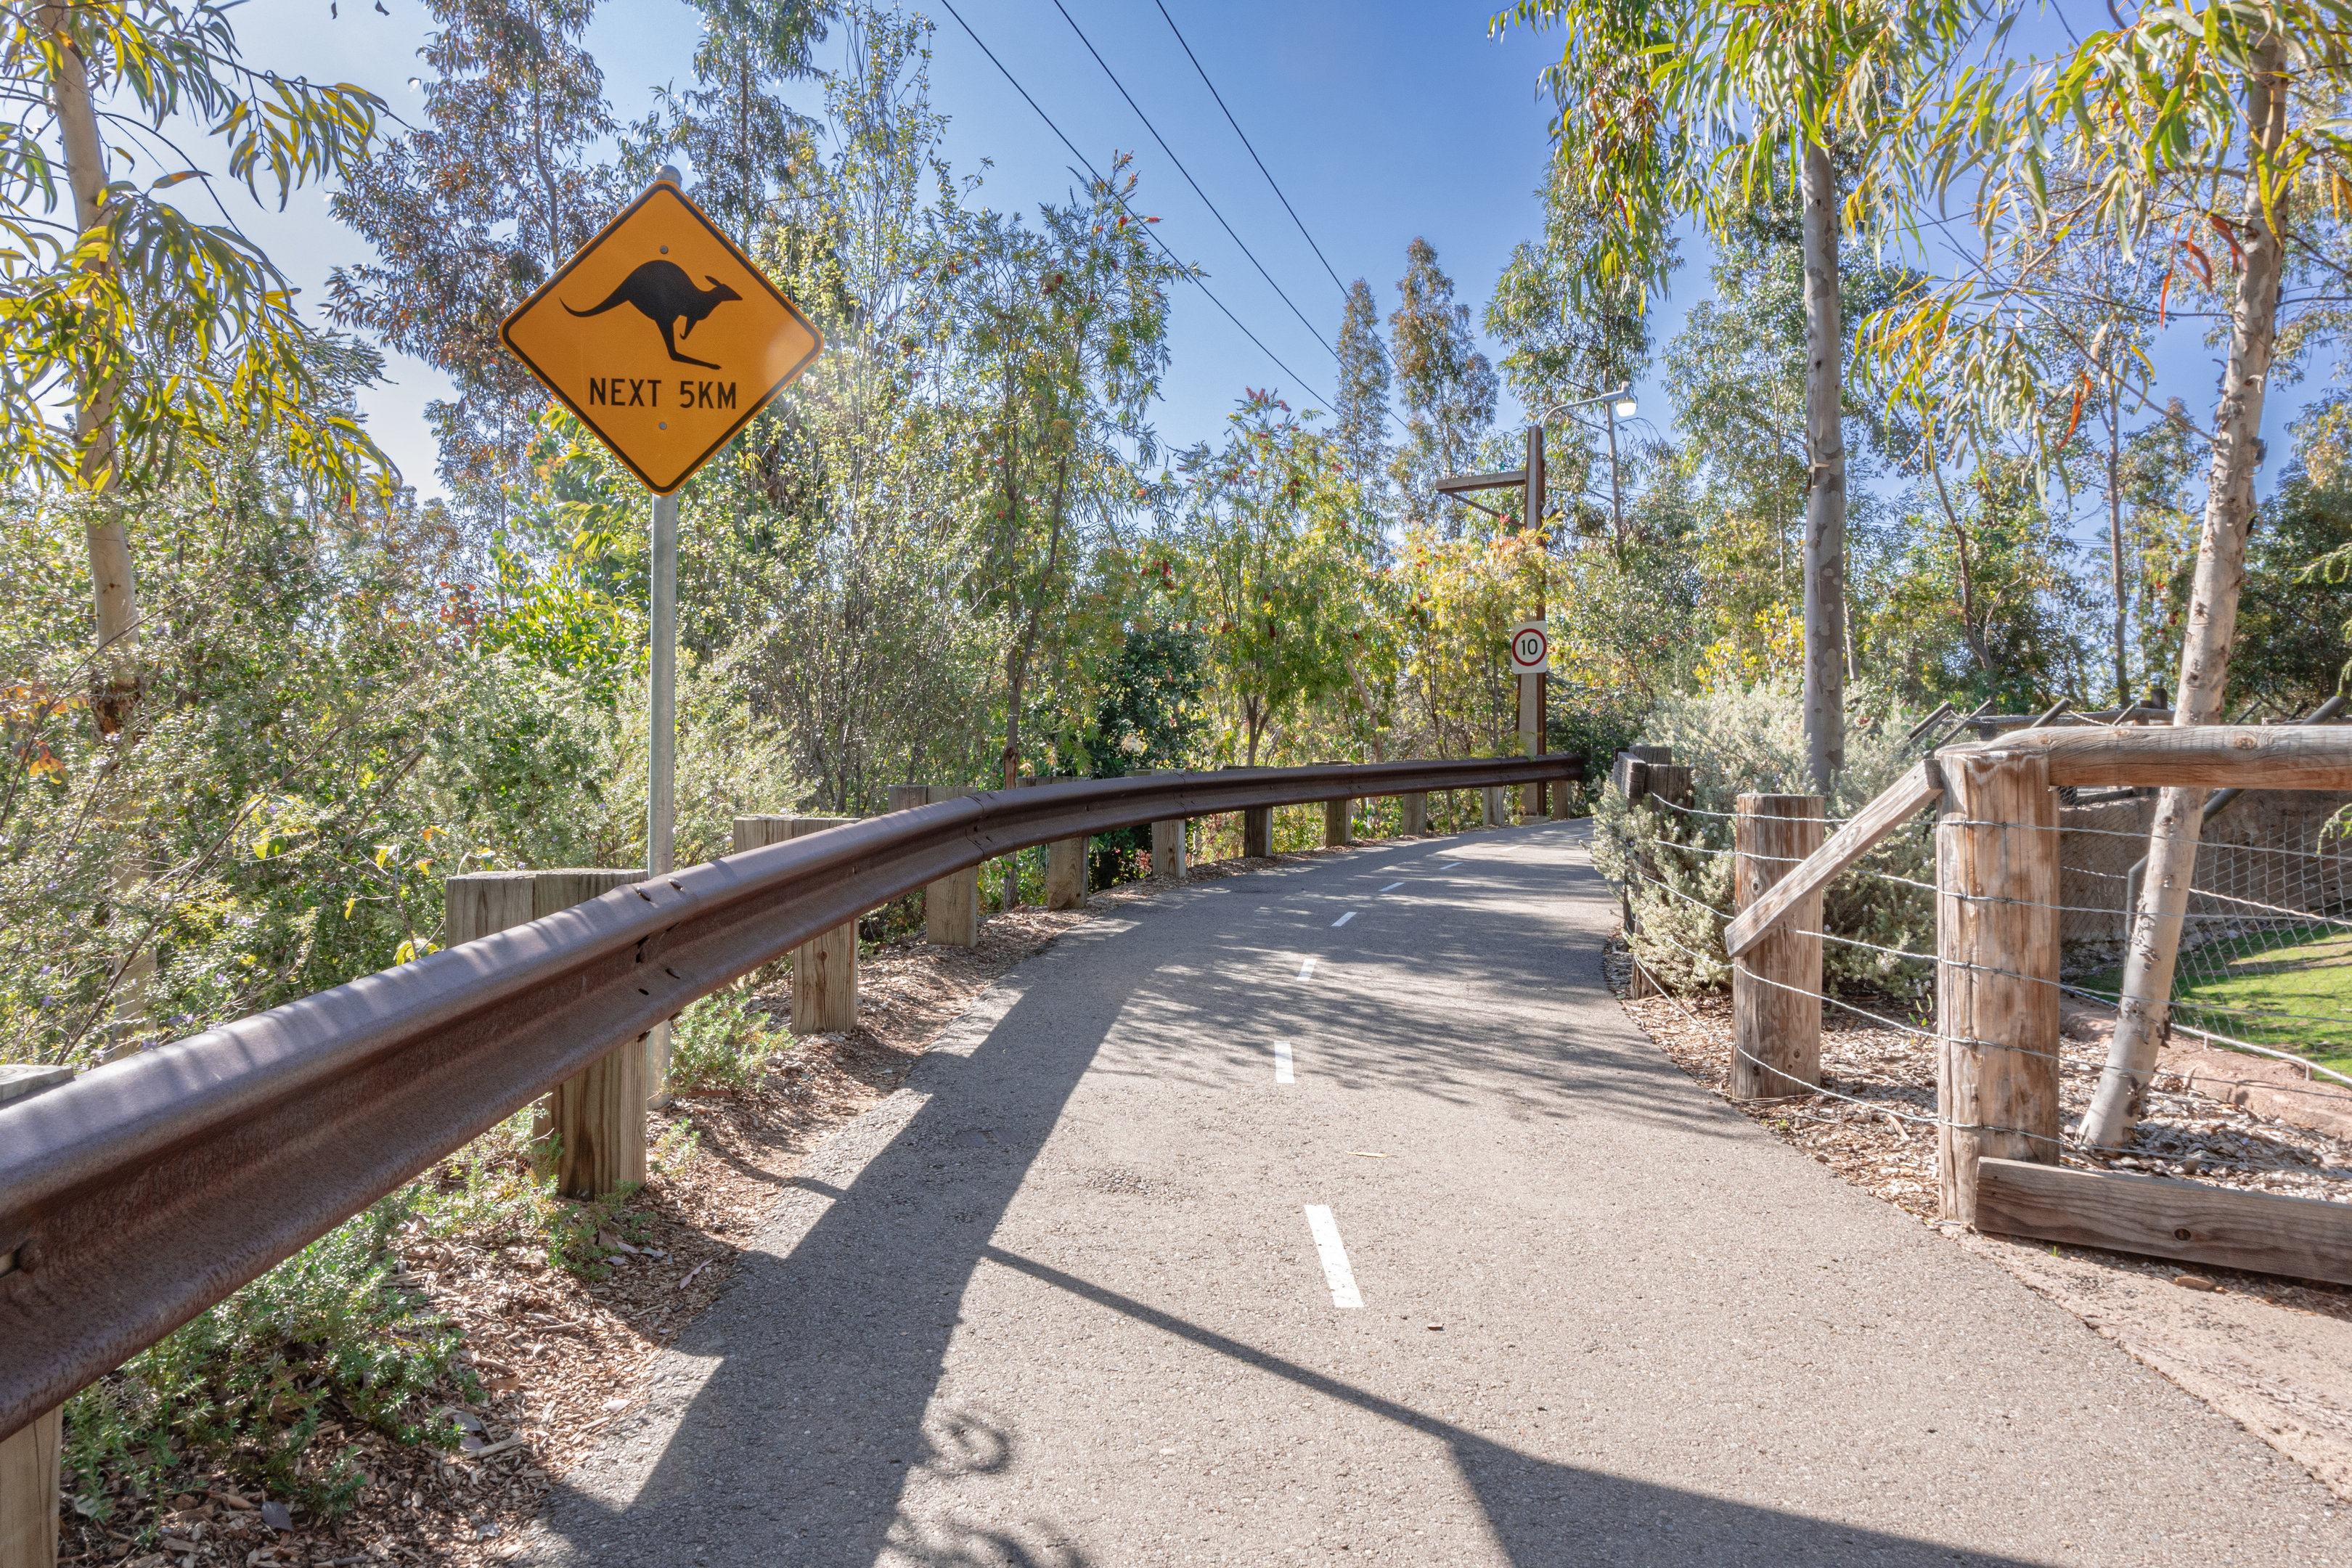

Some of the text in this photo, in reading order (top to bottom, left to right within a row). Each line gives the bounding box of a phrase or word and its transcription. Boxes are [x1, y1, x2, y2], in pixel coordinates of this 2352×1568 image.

[589, 377, 736, 409] NEXT 5KM
[1521, 639, 1538, 656] 10
